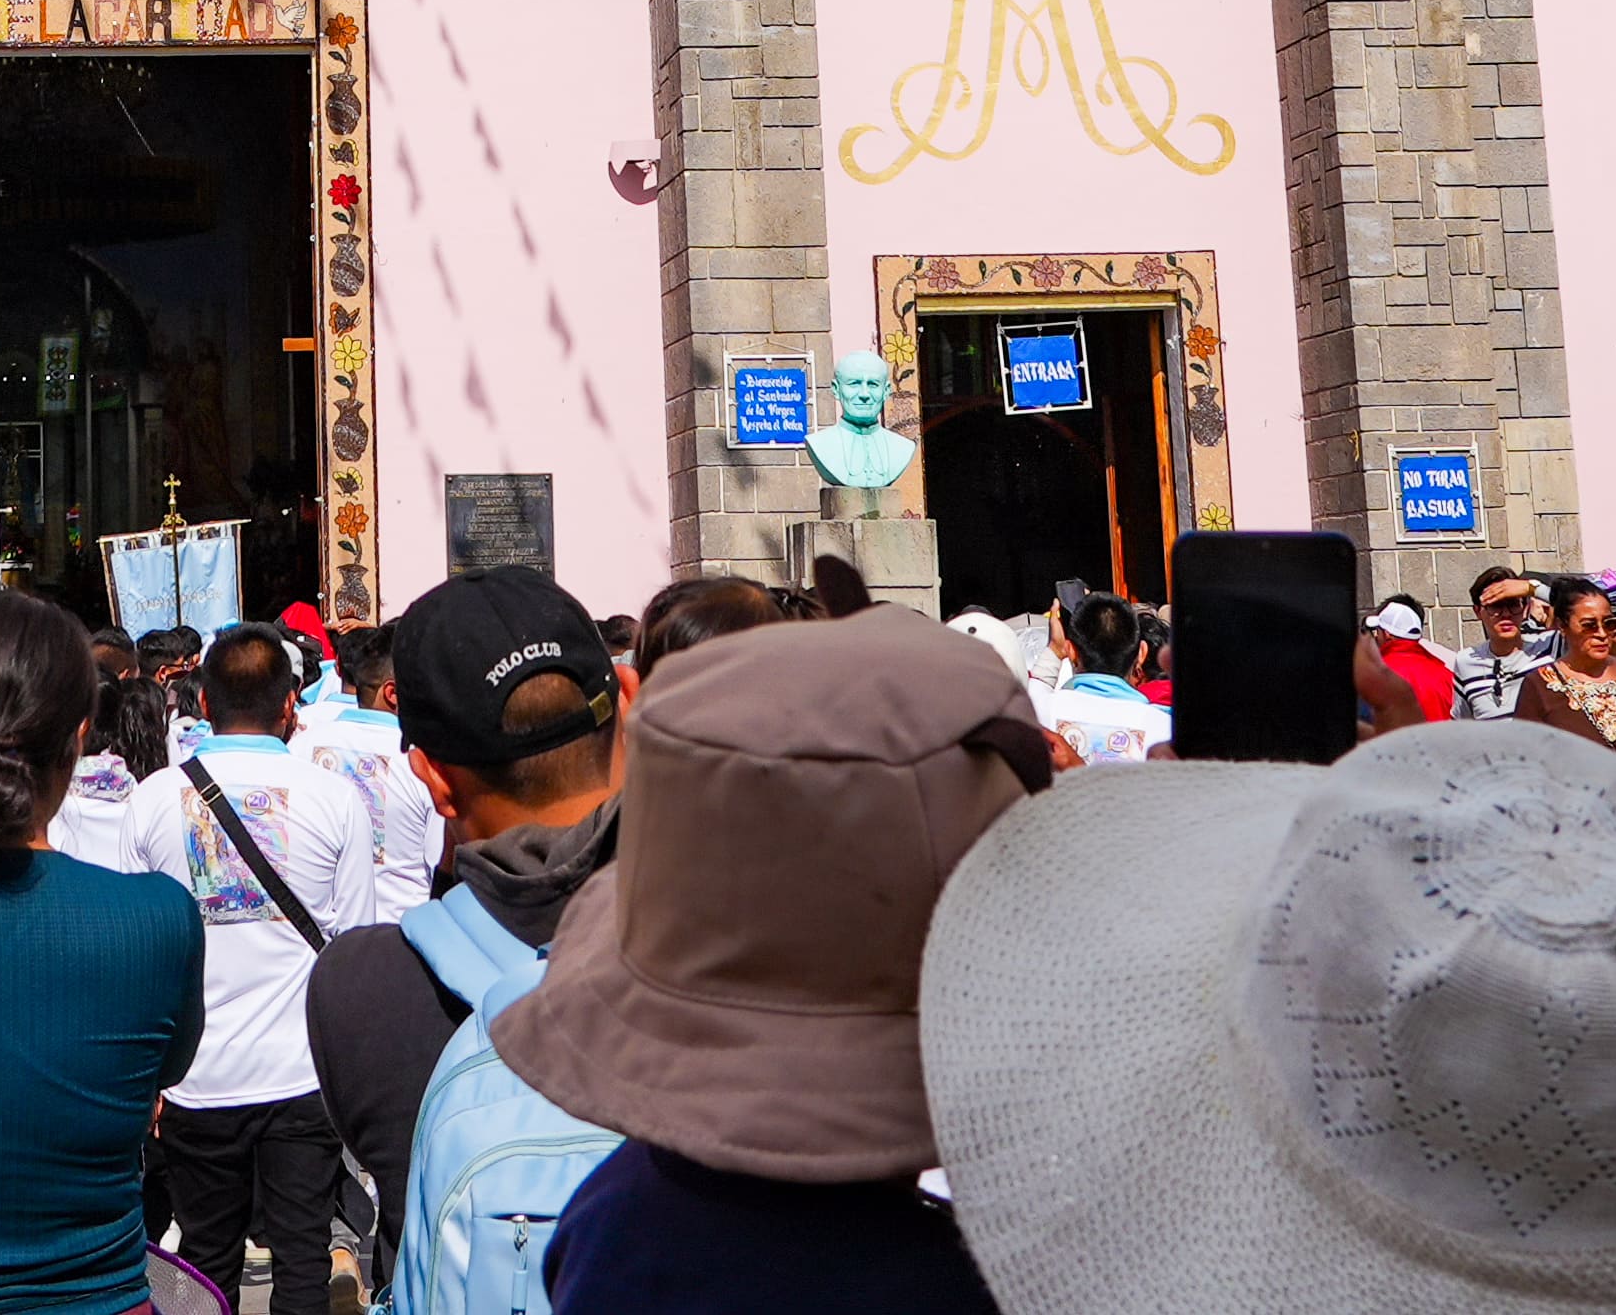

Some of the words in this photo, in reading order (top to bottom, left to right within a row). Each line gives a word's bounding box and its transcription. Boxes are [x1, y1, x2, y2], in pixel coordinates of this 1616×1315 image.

[1013, 360, 1076, 383] ENTRADA
[758, 389, 802, 402] Santuario
[767, 403, 796, 419] Virgen
[1403, 470, 1423, 489] NO
[1425, 469, 1468, 489] TIRAR
[1406, 498, 1468, 520] BASURA
[485, 651, 523, 687] POLO
[523, 642, 562, 660] CLUB
[1112, 734, 1127, 746] 20
[249, 795, 268, 807] 20
